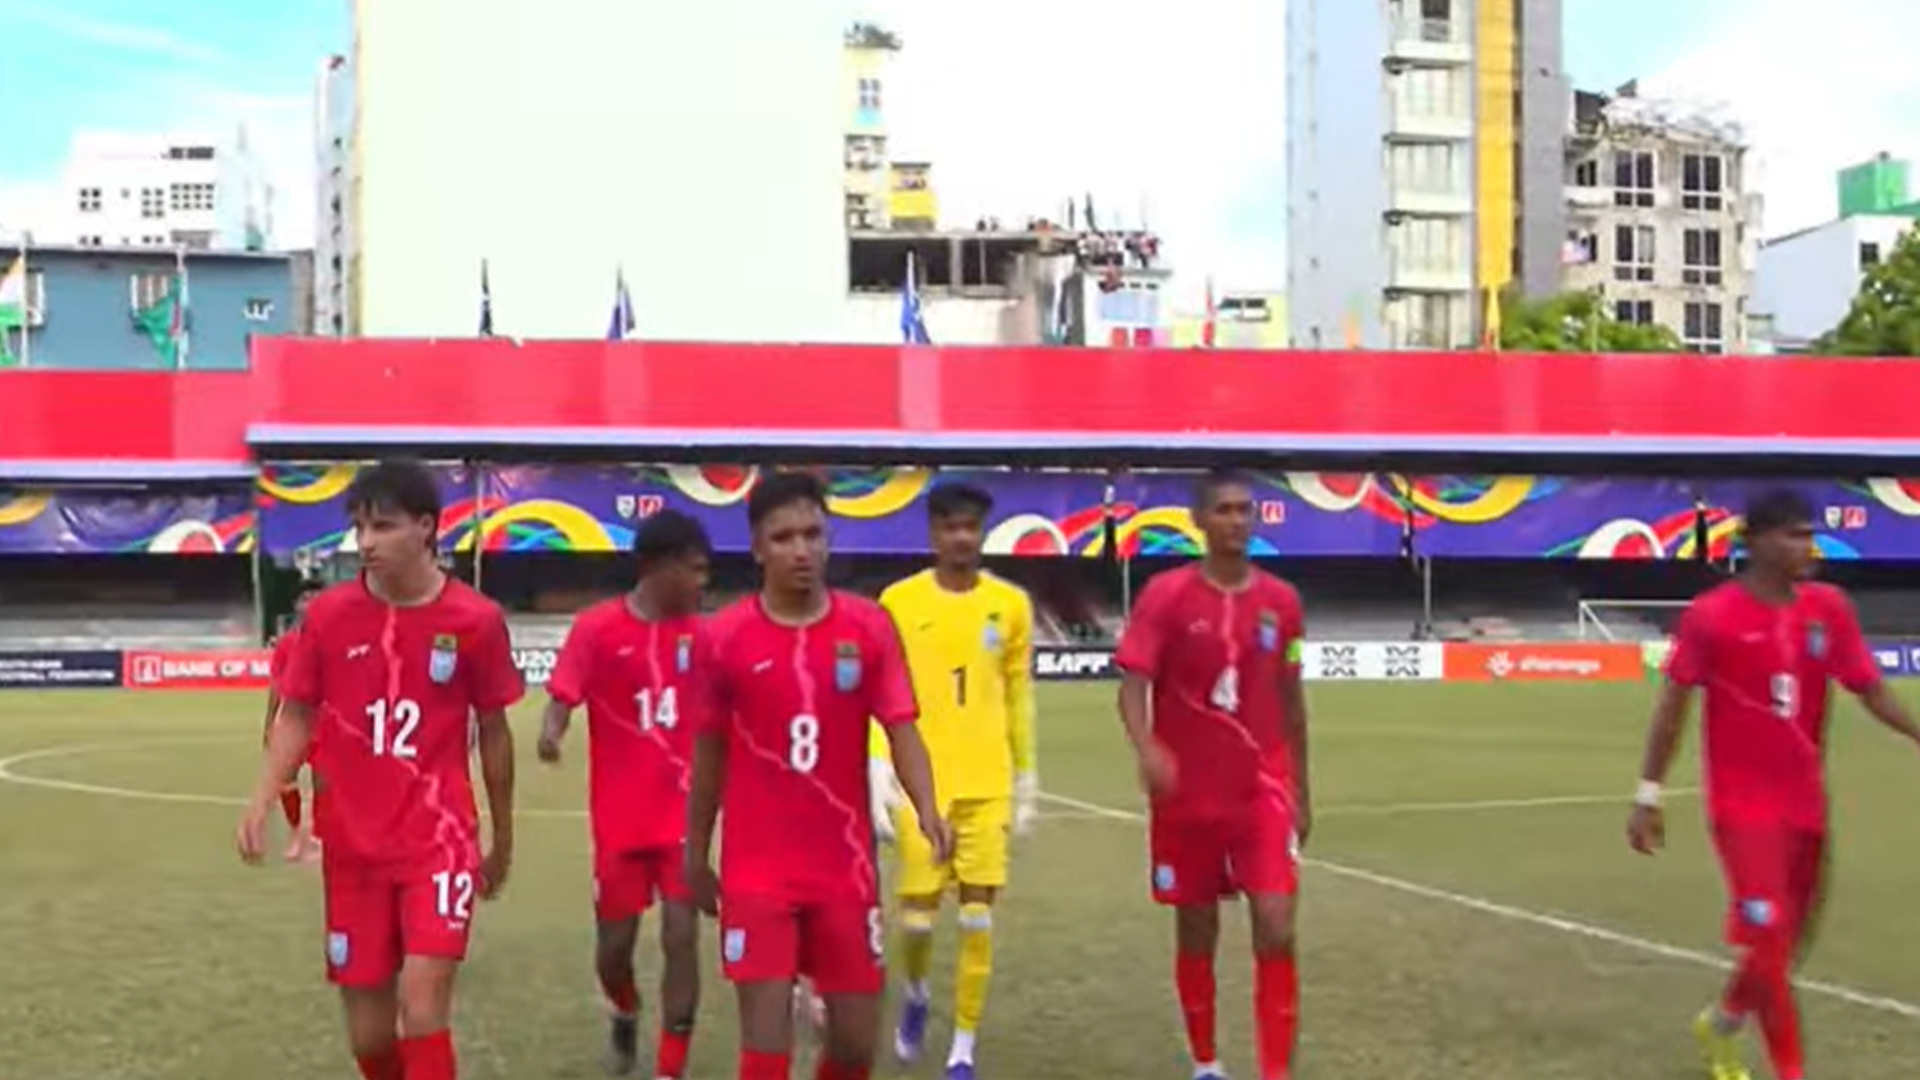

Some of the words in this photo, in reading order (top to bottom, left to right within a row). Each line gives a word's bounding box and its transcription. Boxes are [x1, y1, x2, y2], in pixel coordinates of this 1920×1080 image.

[163, 660, 217, 678] BANK
[220, 660, 246, 677] OF
[1036, 652, 1111, 673] SAFF
[633, 686, 679, 731] 14
[950, 666, 967, 708] 1
[1210, 665, 1241, 713] 4
[1769, 672, 1800, 719] 9
[365, 698, 421, 759] 12
[789, 714, 819, 773] 8
[431, 870, 473, 918] 12
